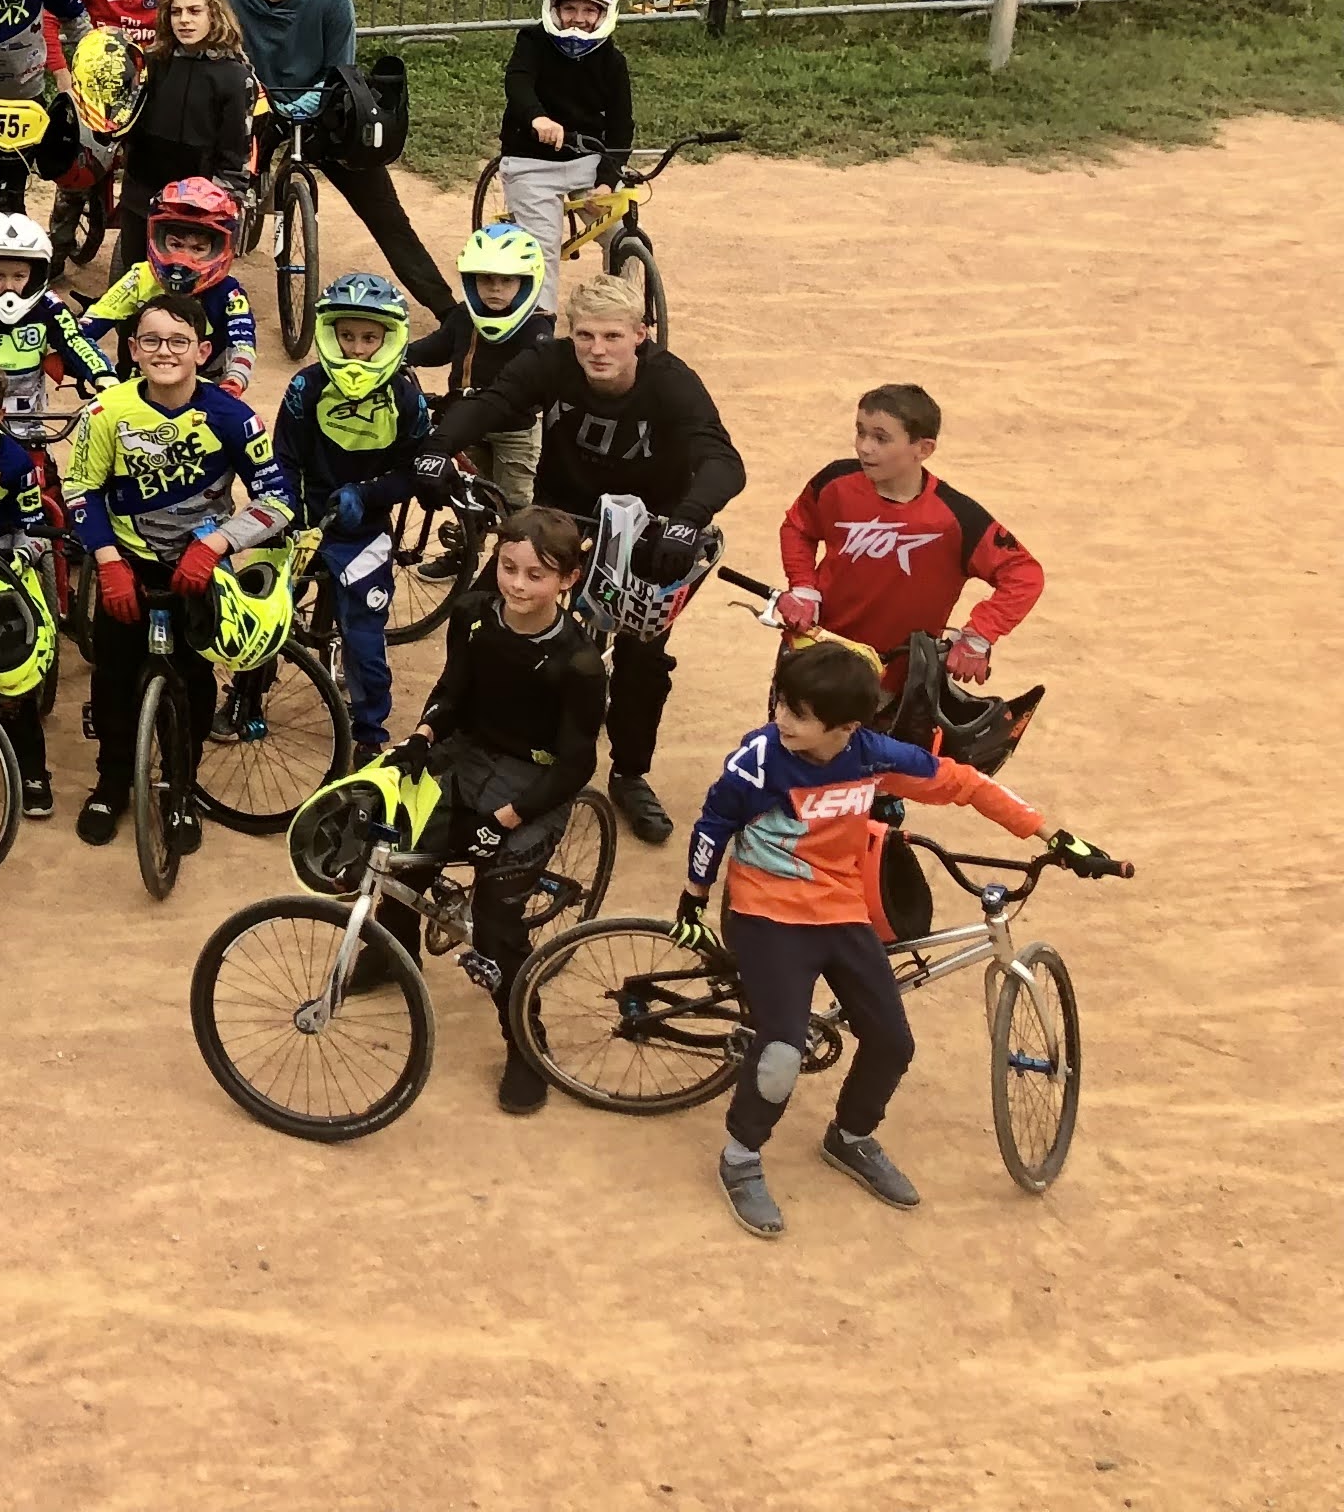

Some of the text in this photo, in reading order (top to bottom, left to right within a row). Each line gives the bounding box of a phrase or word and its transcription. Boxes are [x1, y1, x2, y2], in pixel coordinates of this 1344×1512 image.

[119, 14, 142, 28] Fly
[16, 326, 43, 347] 78
[124, 432, 205, 476] ISSOIRE
[253, 439, 270, 458] 07
[418, 457, 443, 472] FLY
[136, 457, 206, 500] BMX
[666, 524, 695, 539] FLY
[833, 515, 944, 577] THOR
[800, 777, 878, 821] LEAT
